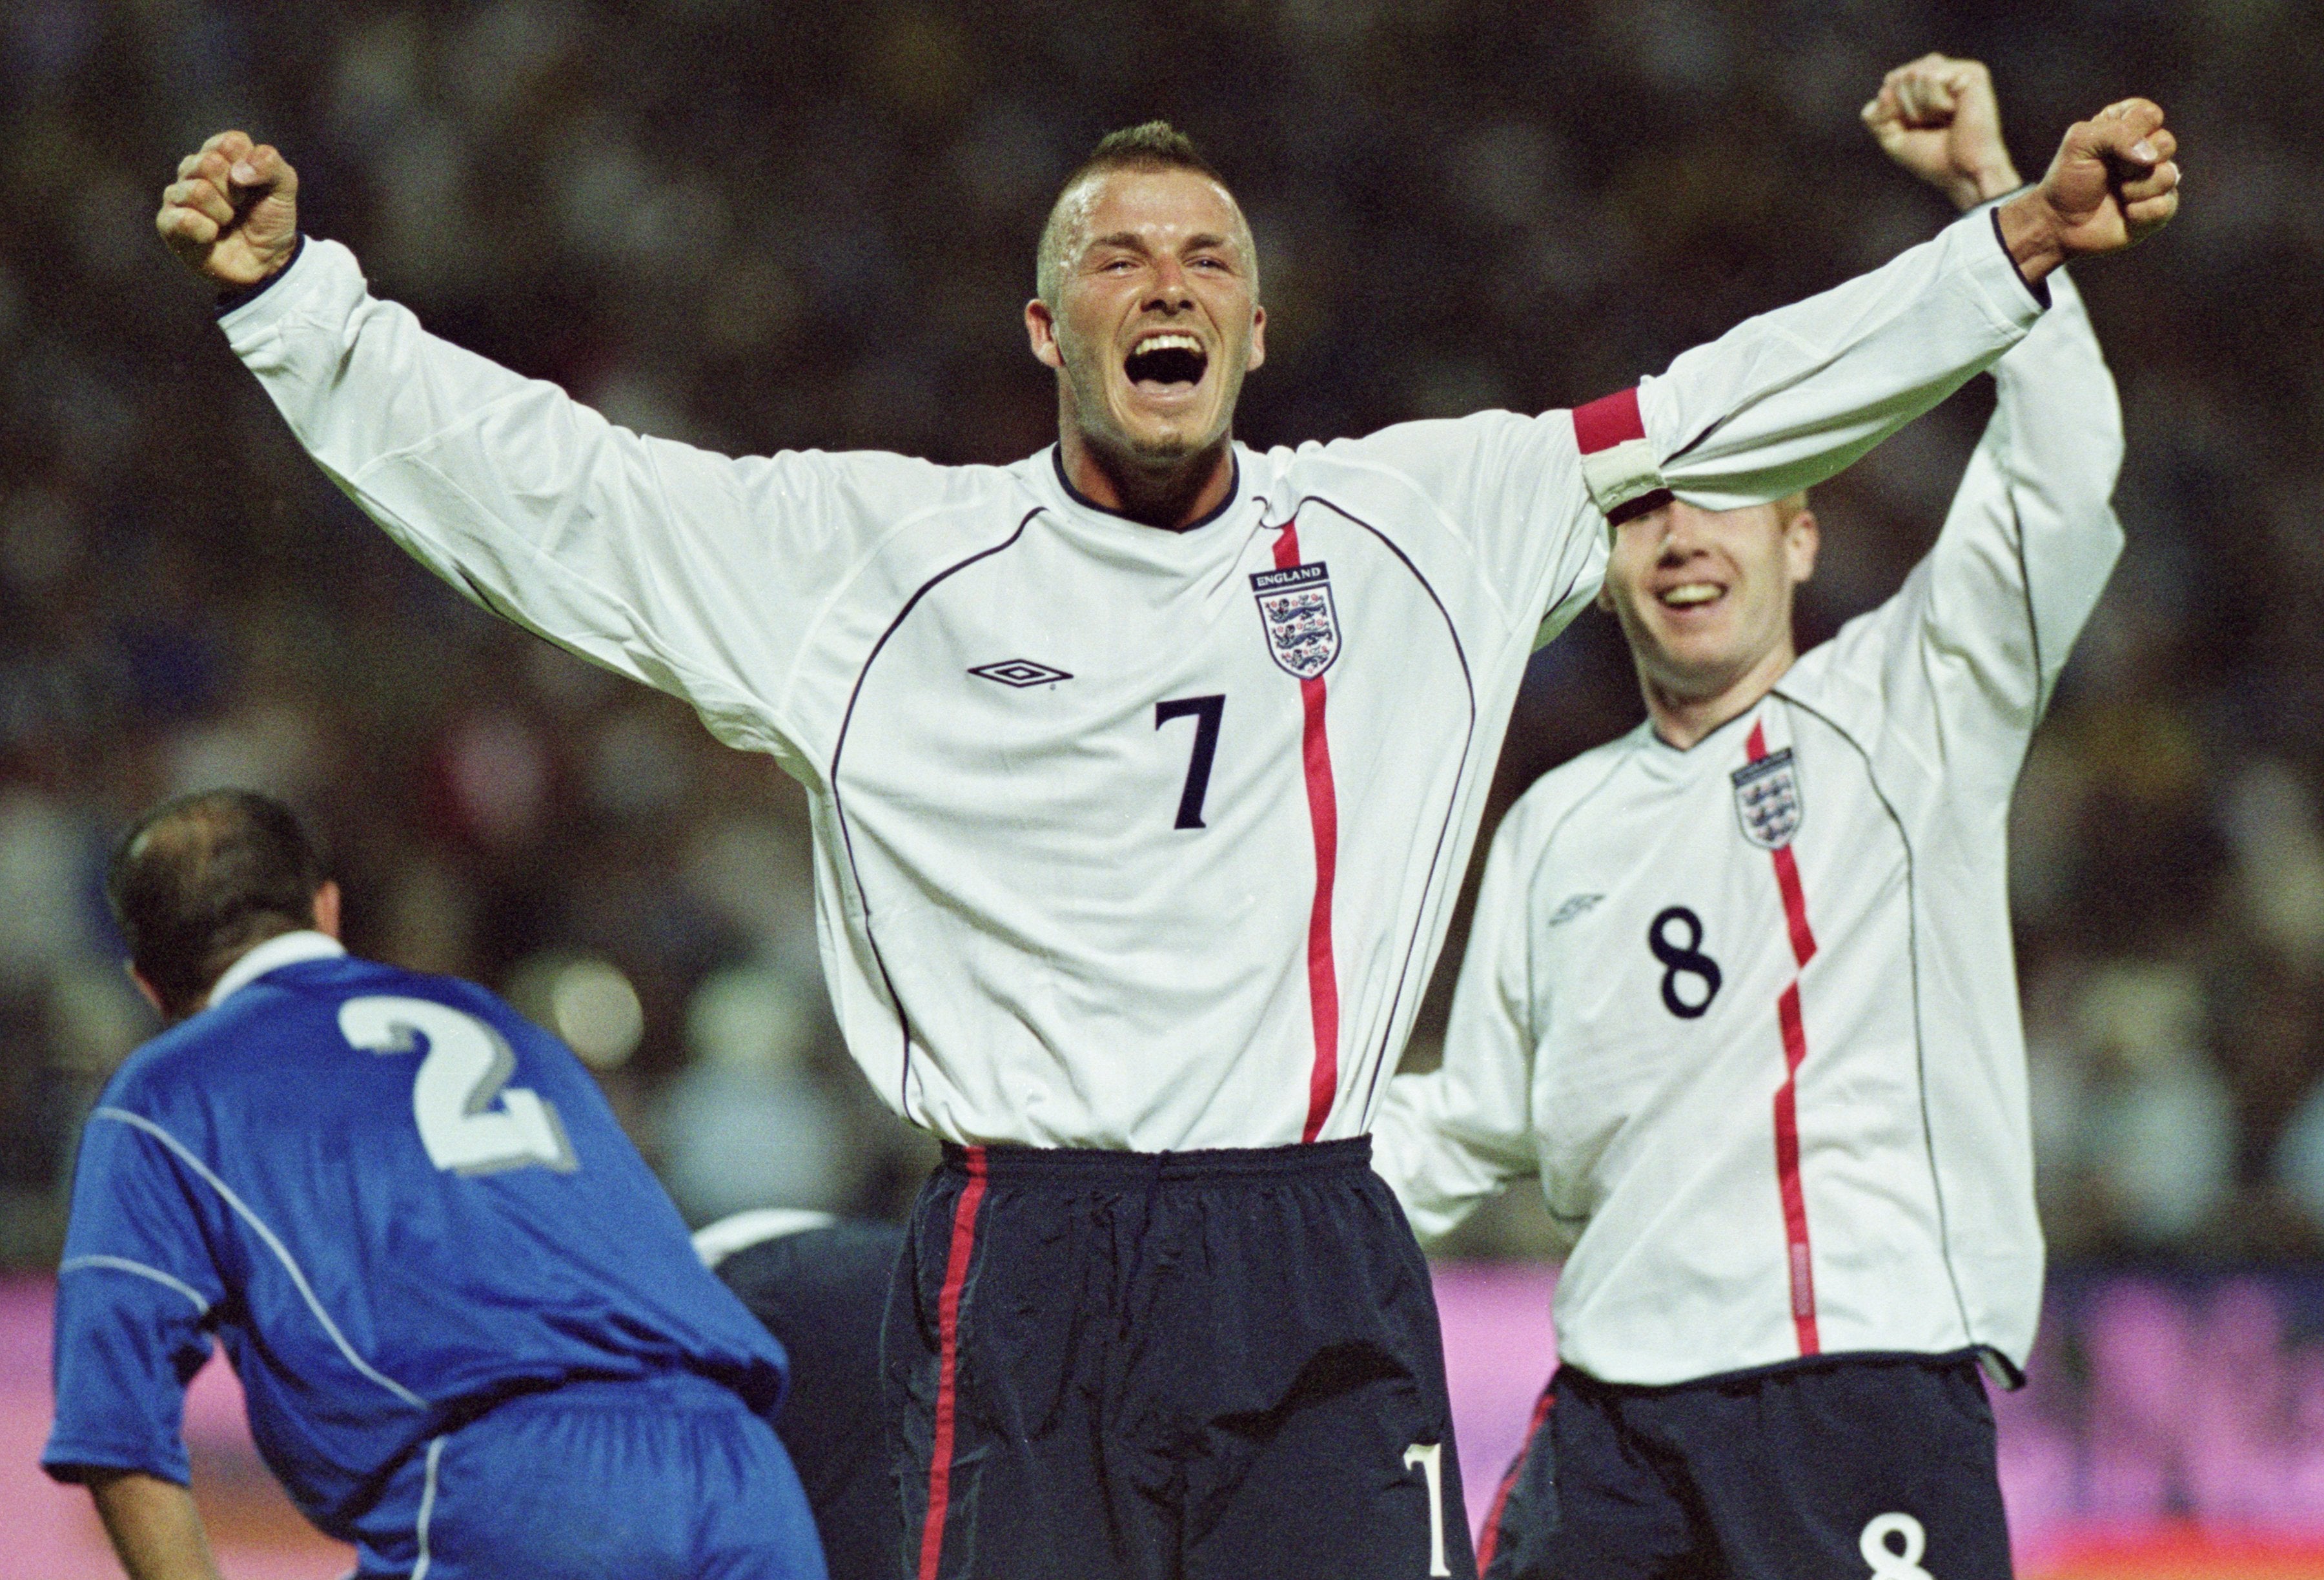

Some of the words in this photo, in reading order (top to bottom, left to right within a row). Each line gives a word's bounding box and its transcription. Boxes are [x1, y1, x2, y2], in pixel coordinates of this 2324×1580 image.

[1256, 566, 1321, 586] ENGLAND
[1156, 693, 1227, 830] 7
[1649, 906, 1722, 1019] 8
[338, 995, 578, 1177] 2
[1859, 1511, 1935, 1580] 8
